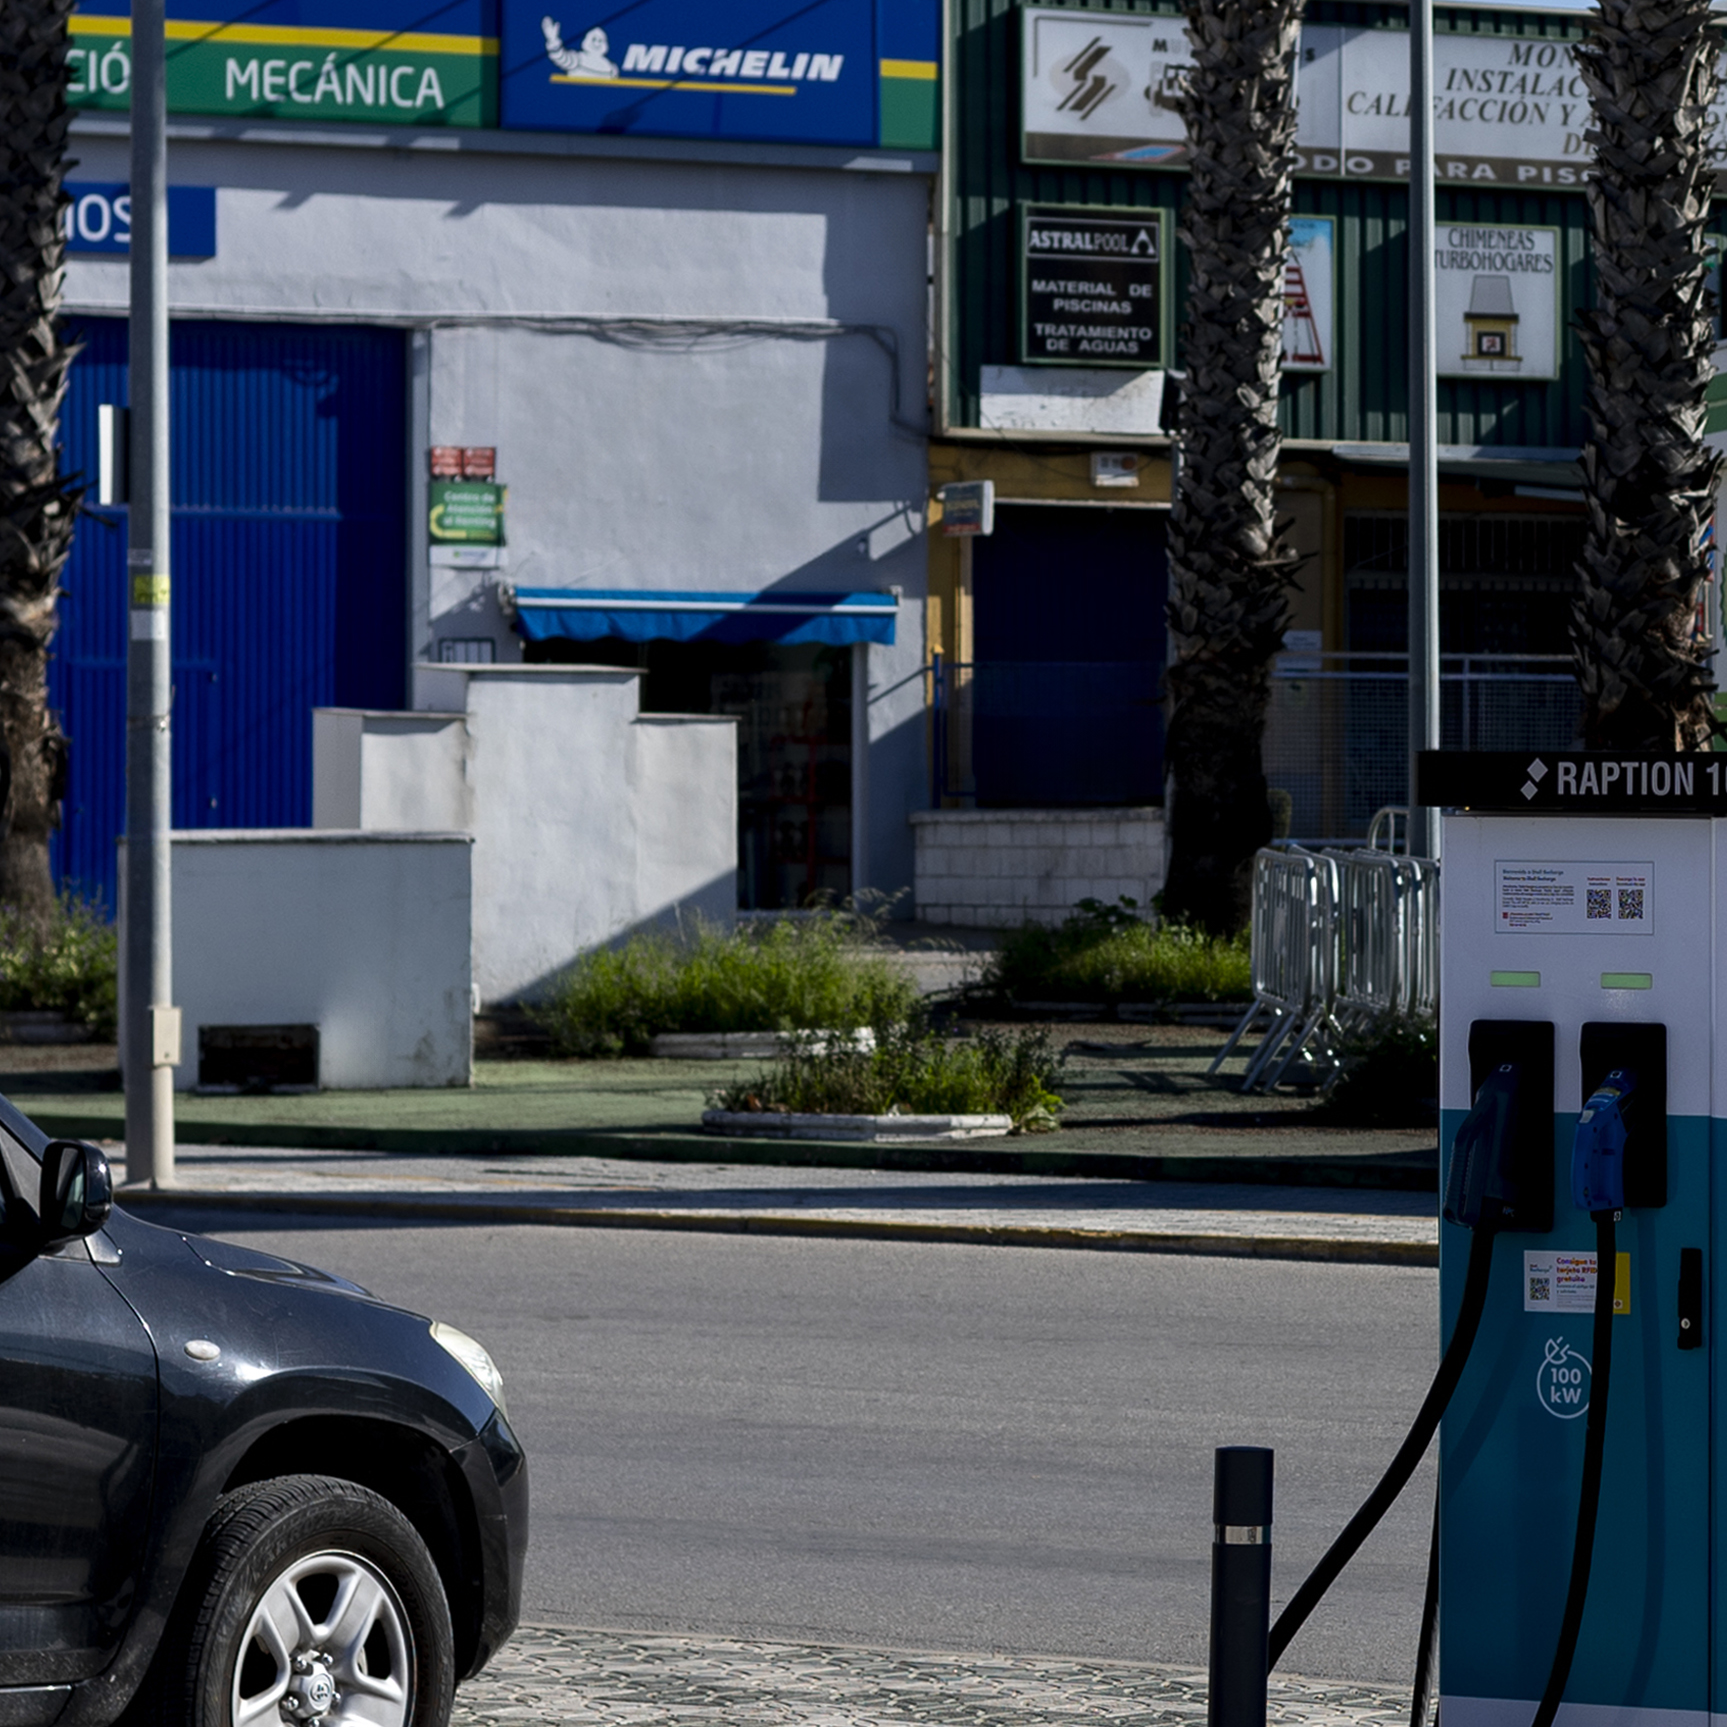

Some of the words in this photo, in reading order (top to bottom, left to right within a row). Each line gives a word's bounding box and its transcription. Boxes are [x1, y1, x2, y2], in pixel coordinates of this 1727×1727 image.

[622, 44, 845, 82] MICHELIN
[65, 42, 131, 94] CIÓ
[226, 53, 443, 109] MECÁNICA
[1446, 68, 1594, 99] INSTALAC
[1347, 91, 1546, 124] CALACCIÓN
[1561, 104, 1578, 127] Y
[1395, 159, 1497, 180] PRA
[1448, 228, 1535, 251] CHIMENEAS
[1435, 250, 1553, 273] TURBOHOGARES
[1032, 280, 1116, 295] MATERIAL
[1129, 284, 1152, 298] DE
[1053, 298, 1132, 314] PISCINAS
[1034, 324, 1152, 341] TRATAMIENTO
[1046, 338, 1069, 352] DE
[1079, 340, 1139, 354] AGUAS
[1558, 761, 1694, 796] RAPTION
[1550, 1367, 1582, 1384] 100
[1551, 1385, 1582, 1404] kW
